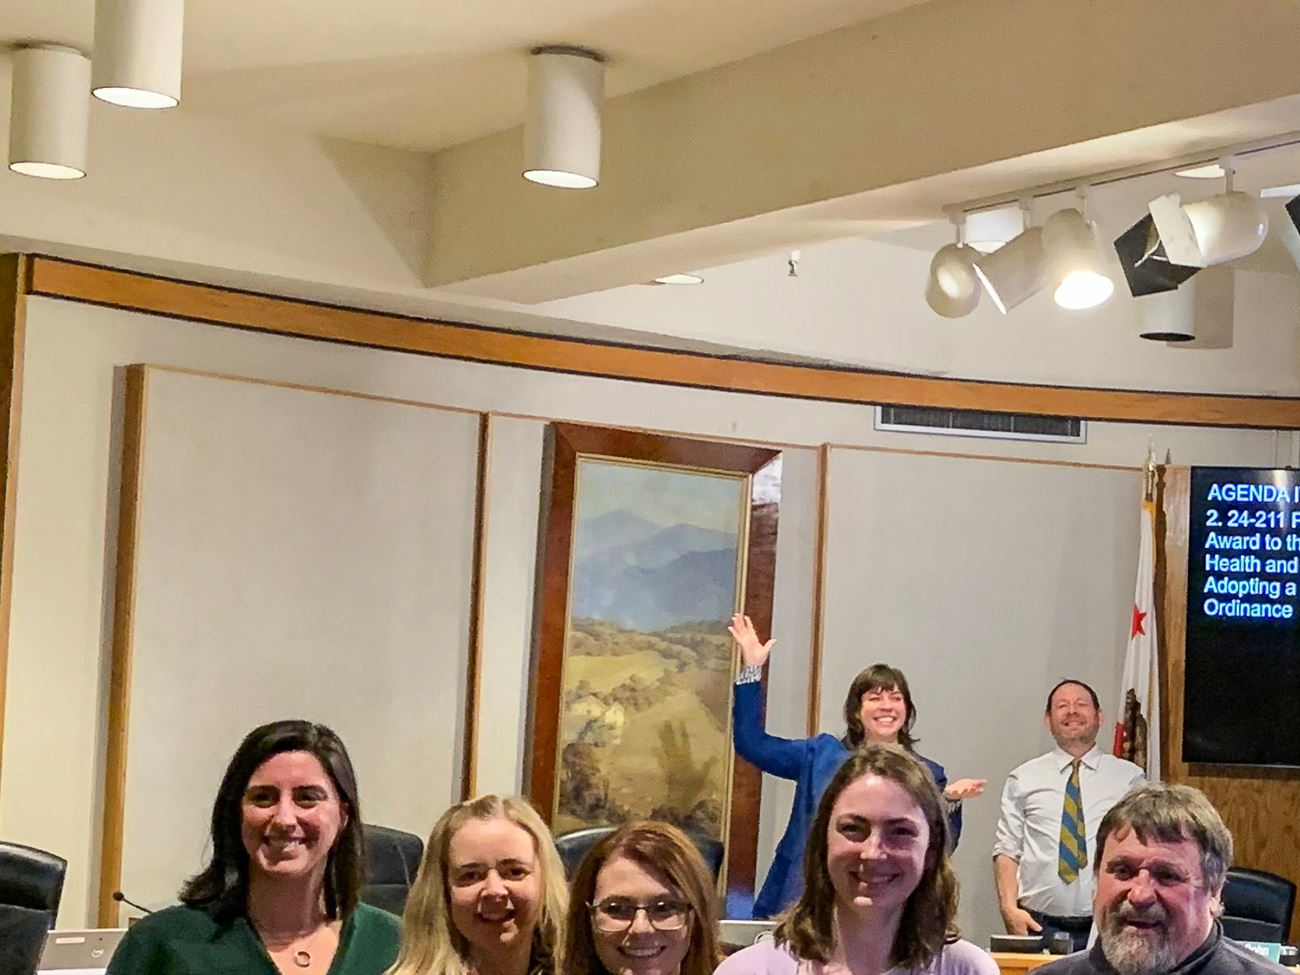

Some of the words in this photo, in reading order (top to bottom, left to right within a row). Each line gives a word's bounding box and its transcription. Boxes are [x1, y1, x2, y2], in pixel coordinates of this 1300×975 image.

[1207, 484, 1291, 503] AGENDA
[1206, 509, 1223, 526] 2.
[1227, 510, 1285, 528] 24-211
[1205, 532, 1260, 550] Award
[1265, 535, 1282, 550] to
[1205, 554, 1261, 572] Health
[1265, 556, 1299, 573] and
[1203, 576, 1280, 599] Adopting
[1285, 581, 1297, 595] a
[1203, 599, 1293, 618] Ordinance
